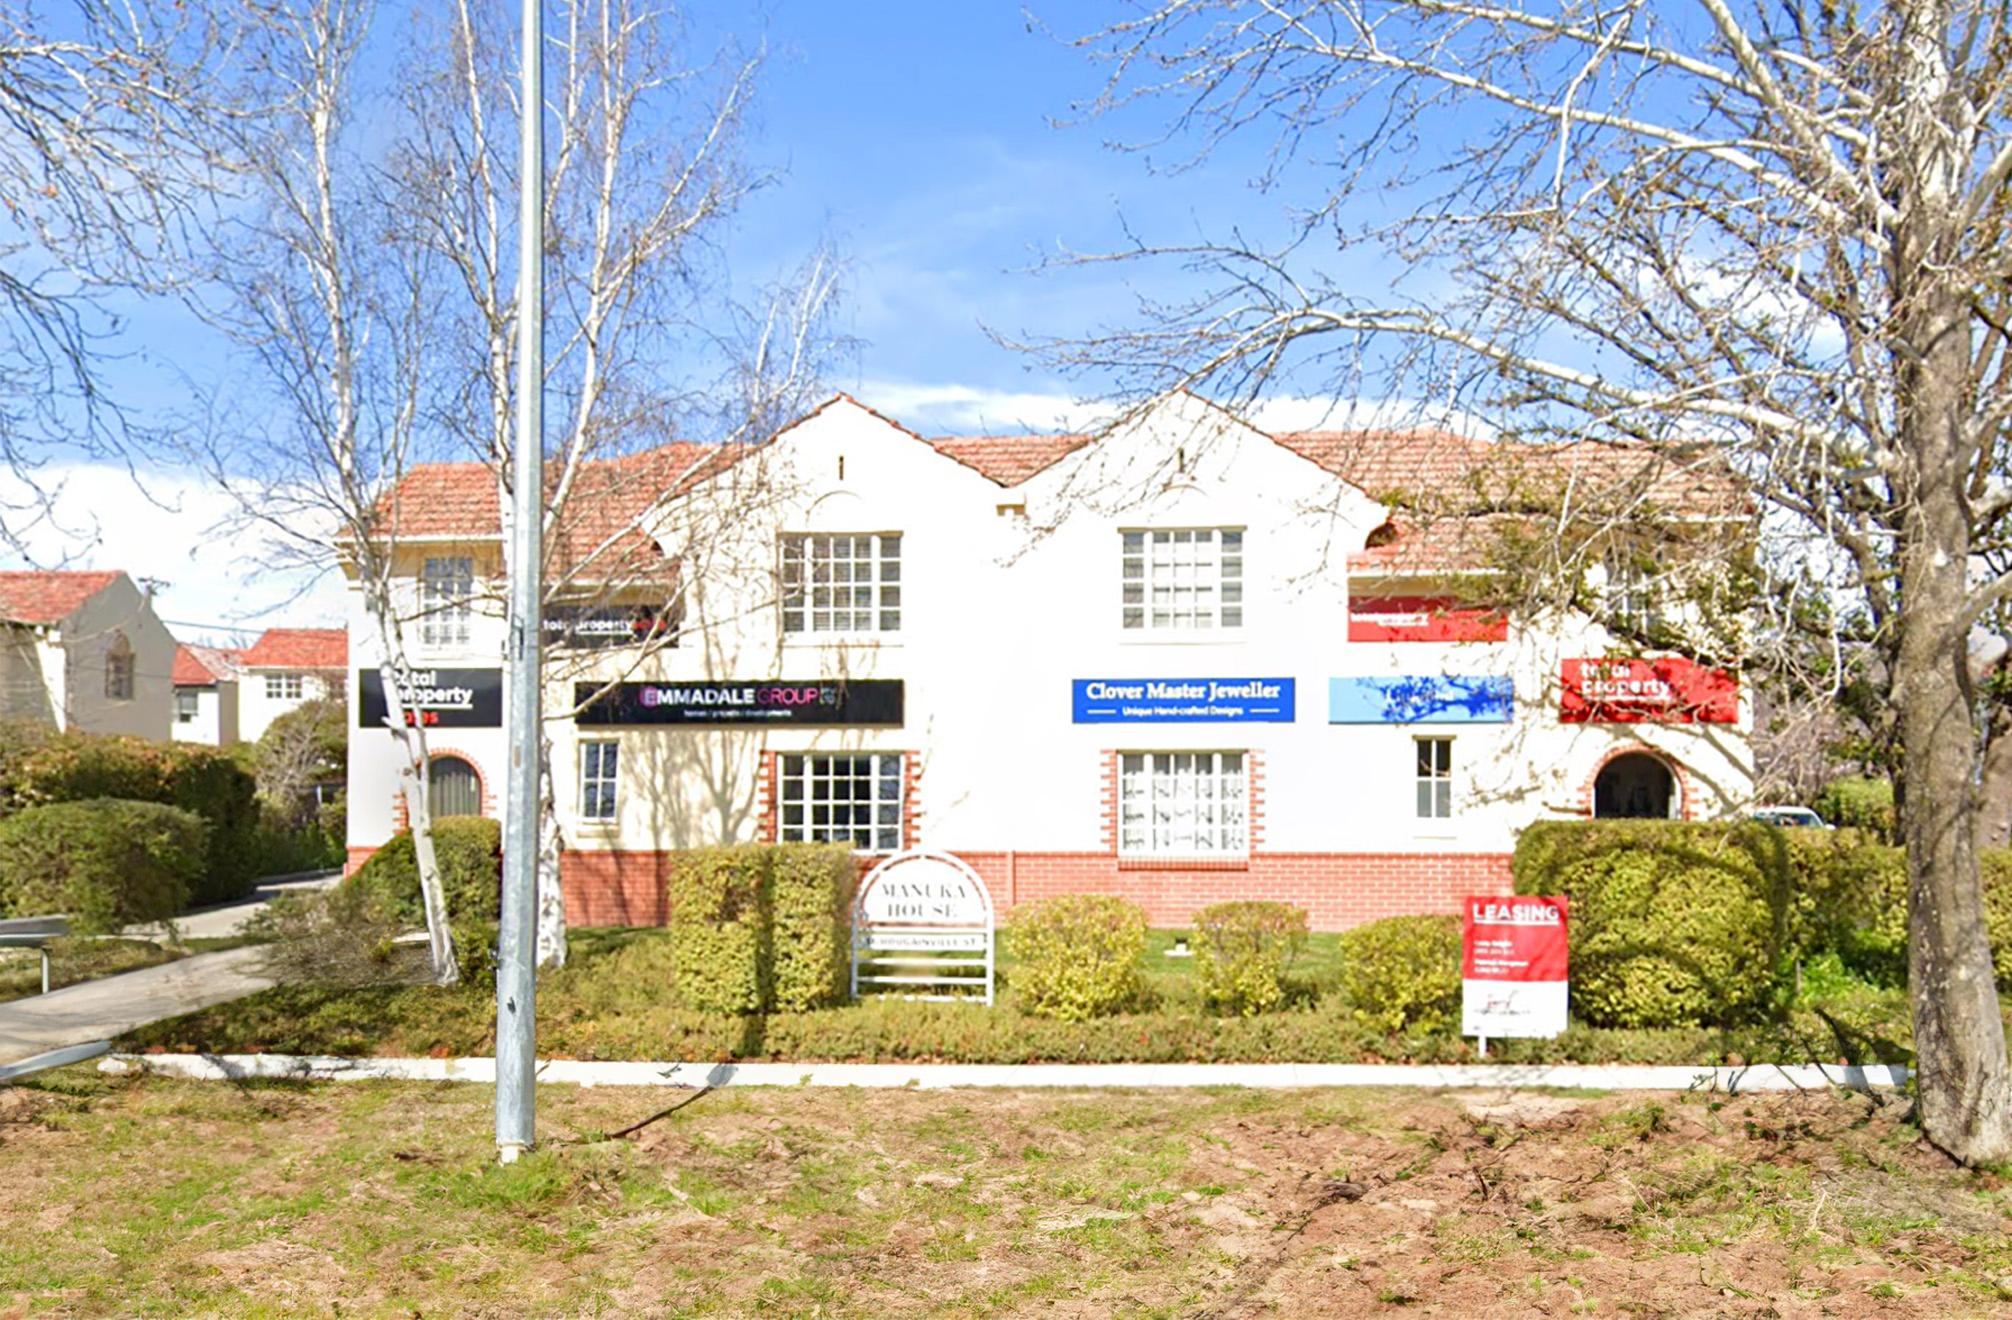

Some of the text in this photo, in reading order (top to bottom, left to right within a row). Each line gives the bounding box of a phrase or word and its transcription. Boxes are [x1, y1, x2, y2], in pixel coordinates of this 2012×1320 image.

[1086, 681, 1281, 701] Clover Master Jeweller
[1581, 678, 1671, 696] property
[643, 688, 755, 704] EMMADALE
[758, 688, 818, 704] GROUP
[1122, 706, 1153, 717] Unique
[1210, 705, 1244, 717] Designs
[882, 884, 966, 898] MANUKA
[888, 903, 958, 918] HOUSE
[1472, 903, 1560, 921] LEASING
